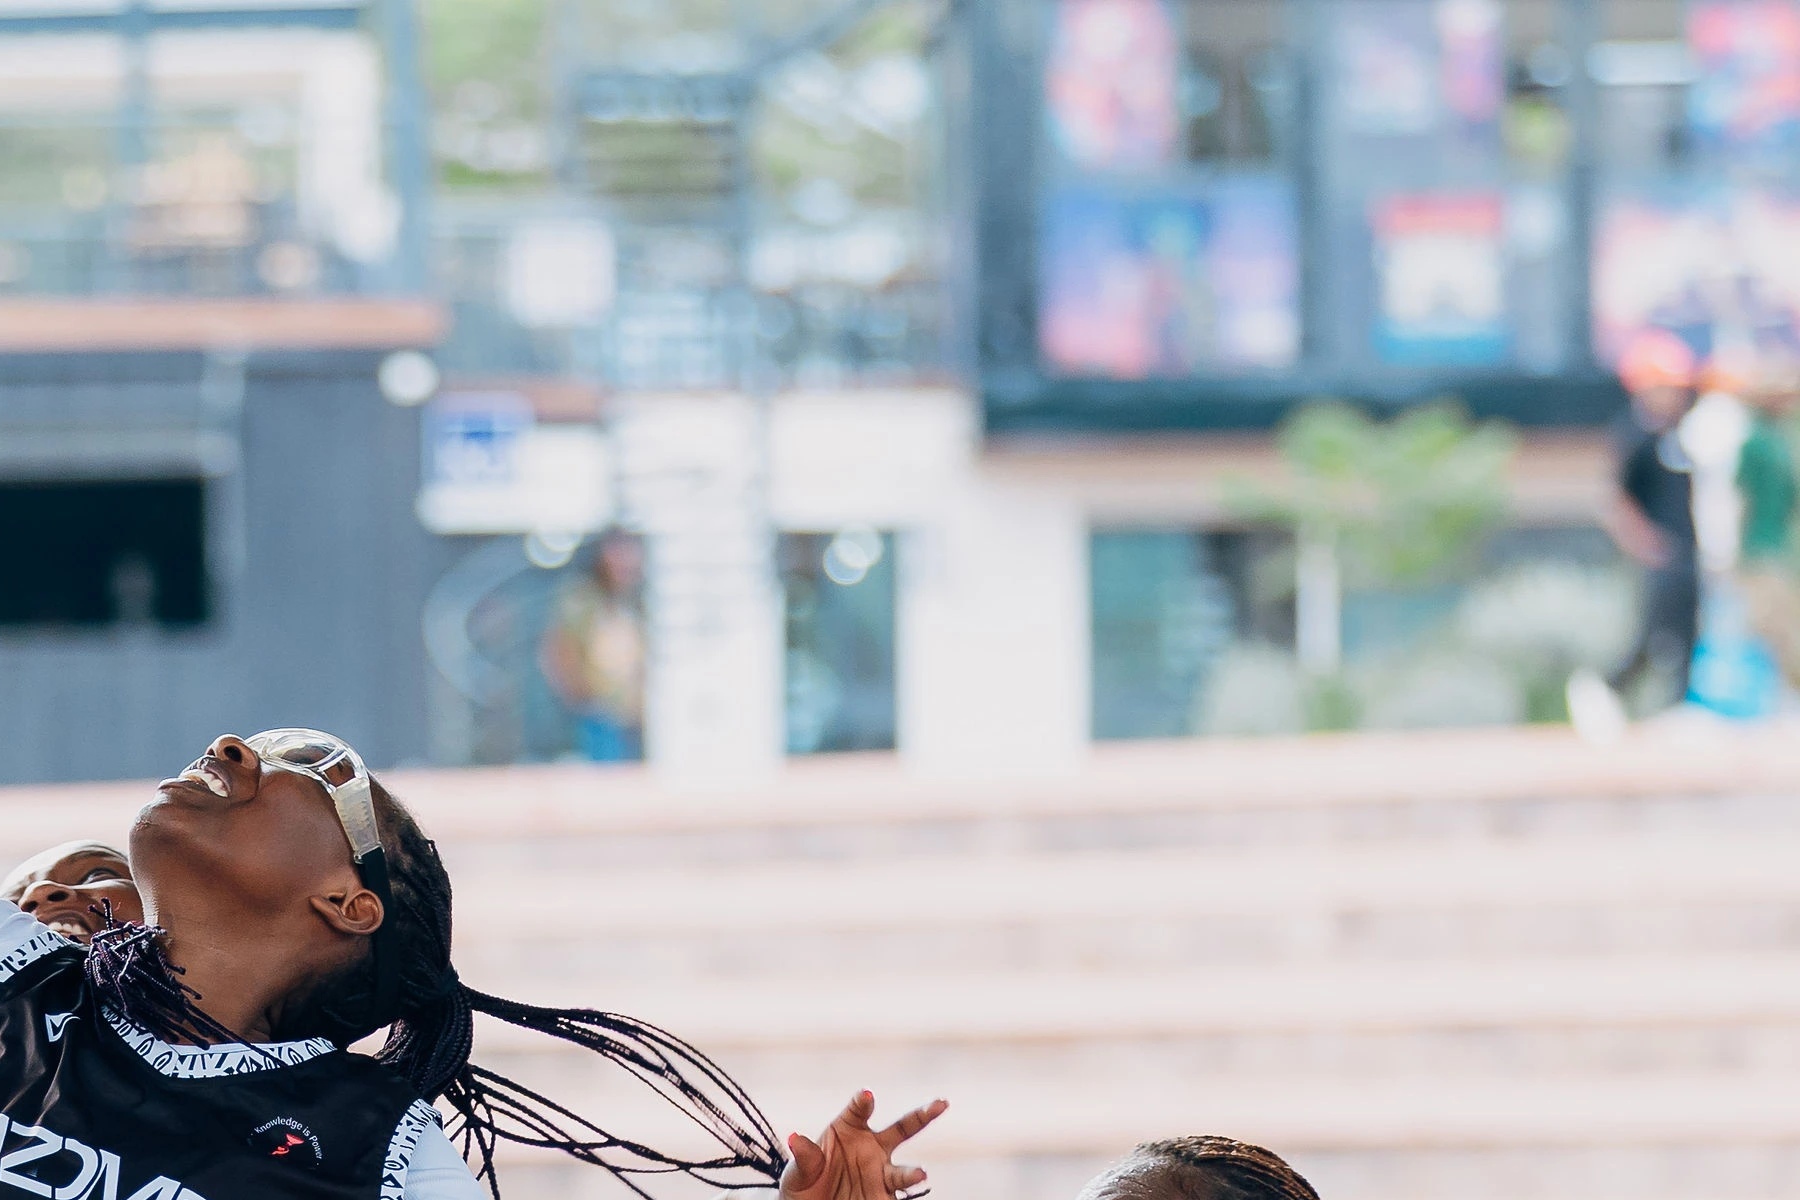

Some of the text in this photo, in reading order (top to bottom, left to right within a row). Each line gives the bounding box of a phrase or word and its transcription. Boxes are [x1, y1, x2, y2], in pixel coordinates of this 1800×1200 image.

[254, 1116, 323, 1160] Knowledge is Power
